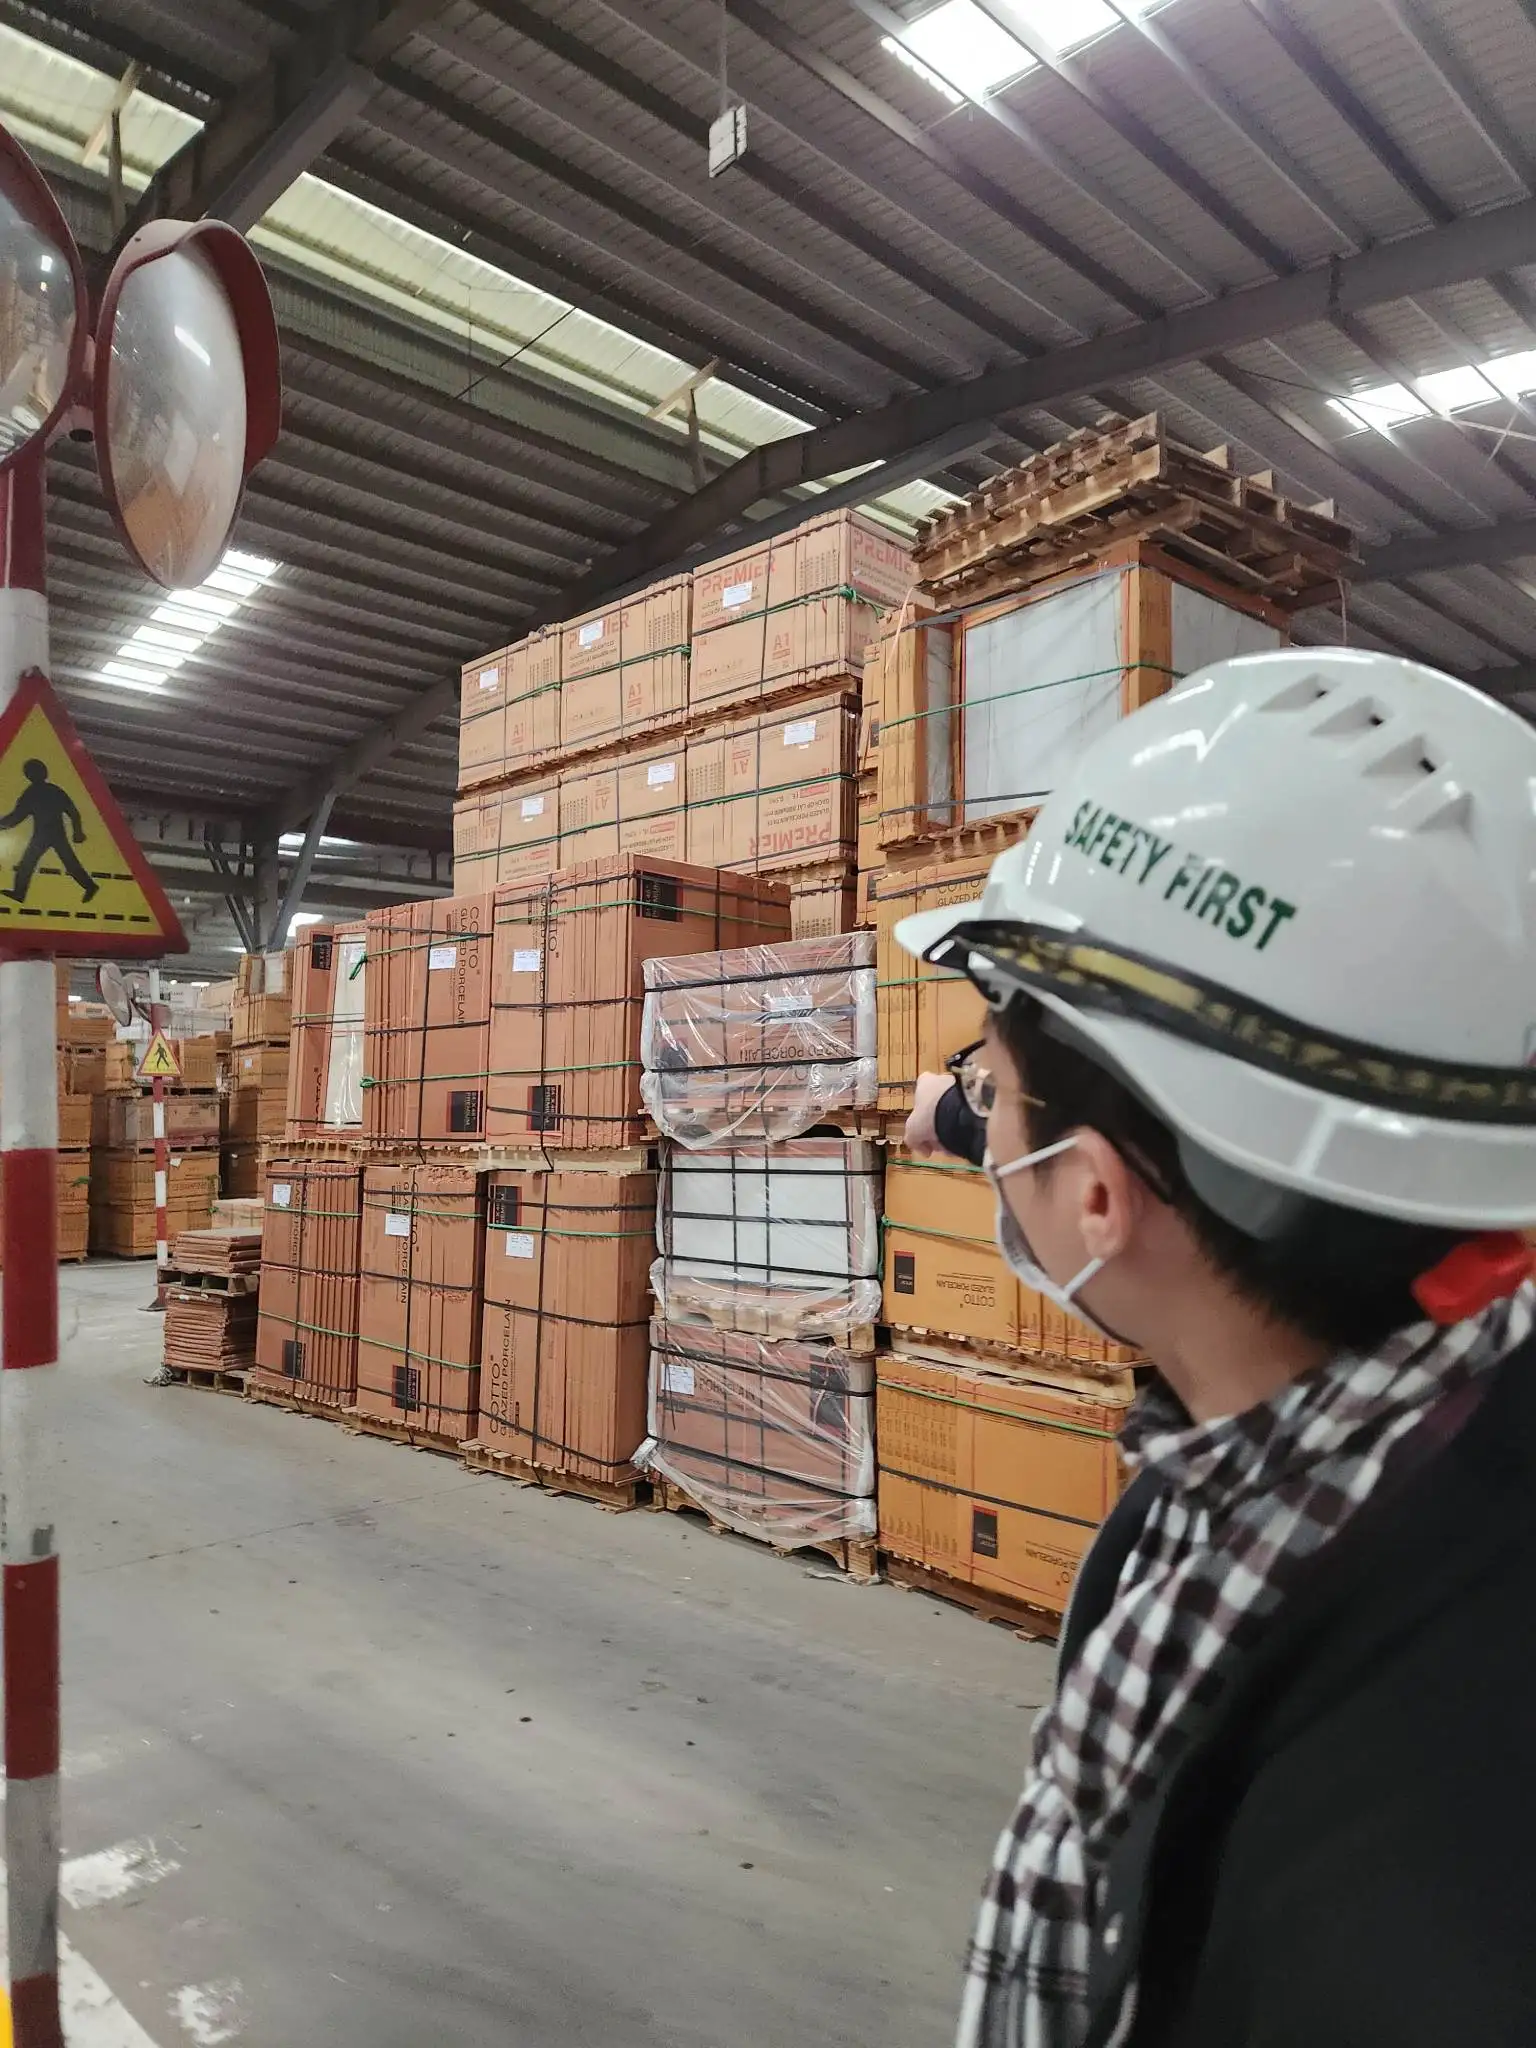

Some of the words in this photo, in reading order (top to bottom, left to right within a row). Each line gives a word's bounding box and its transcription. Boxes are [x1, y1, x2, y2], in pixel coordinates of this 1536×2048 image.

[1064, 800, 1173, 885] SAFETY
[1164, 852, 1297, 951] FIRST
[963, 1294, 996, 1308] COTTO
[489, 1363, 501, 1433] COTTO
